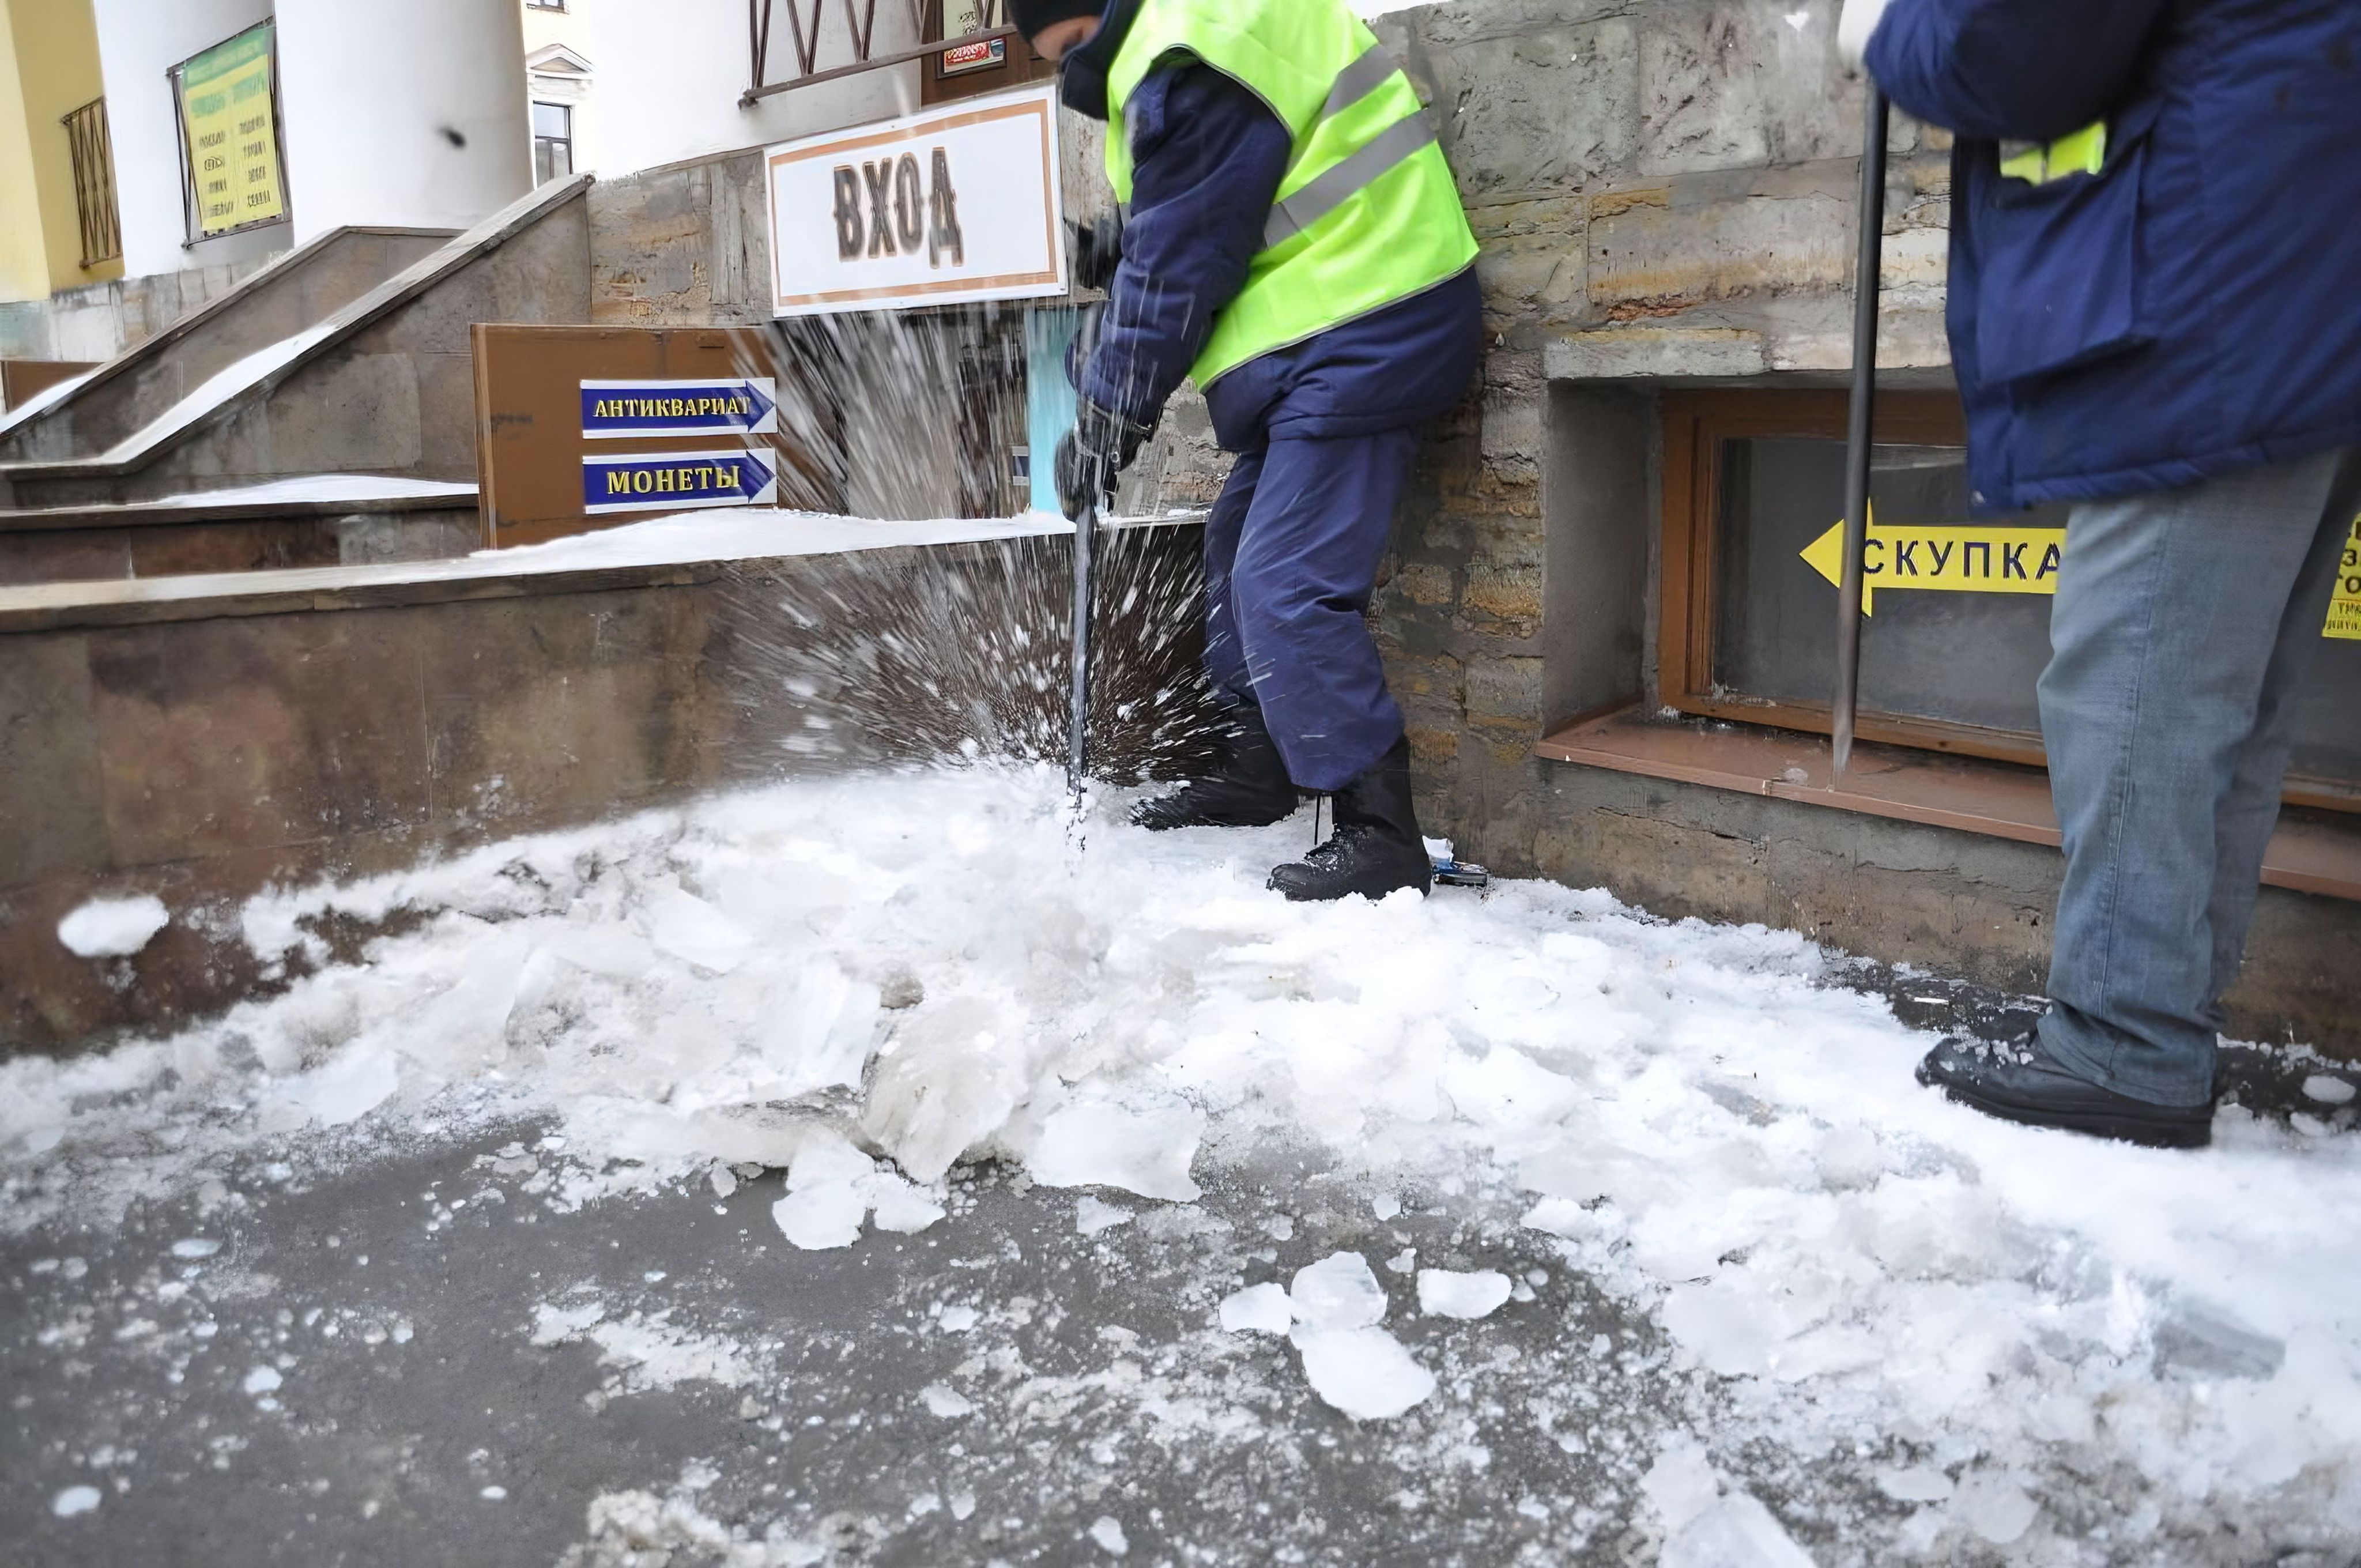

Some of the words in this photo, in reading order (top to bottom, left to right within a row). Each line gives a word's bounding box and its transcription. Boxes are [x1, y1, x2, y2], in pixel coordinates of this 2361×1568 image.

[833, 146, 964, 269] ВХОД
[593, 397, 750, 417] АНТИКВАРИАТ
[607, 466, 740, 494] МОНЕТЫ
[1863, 538, 2061, 581] СКУПКА
